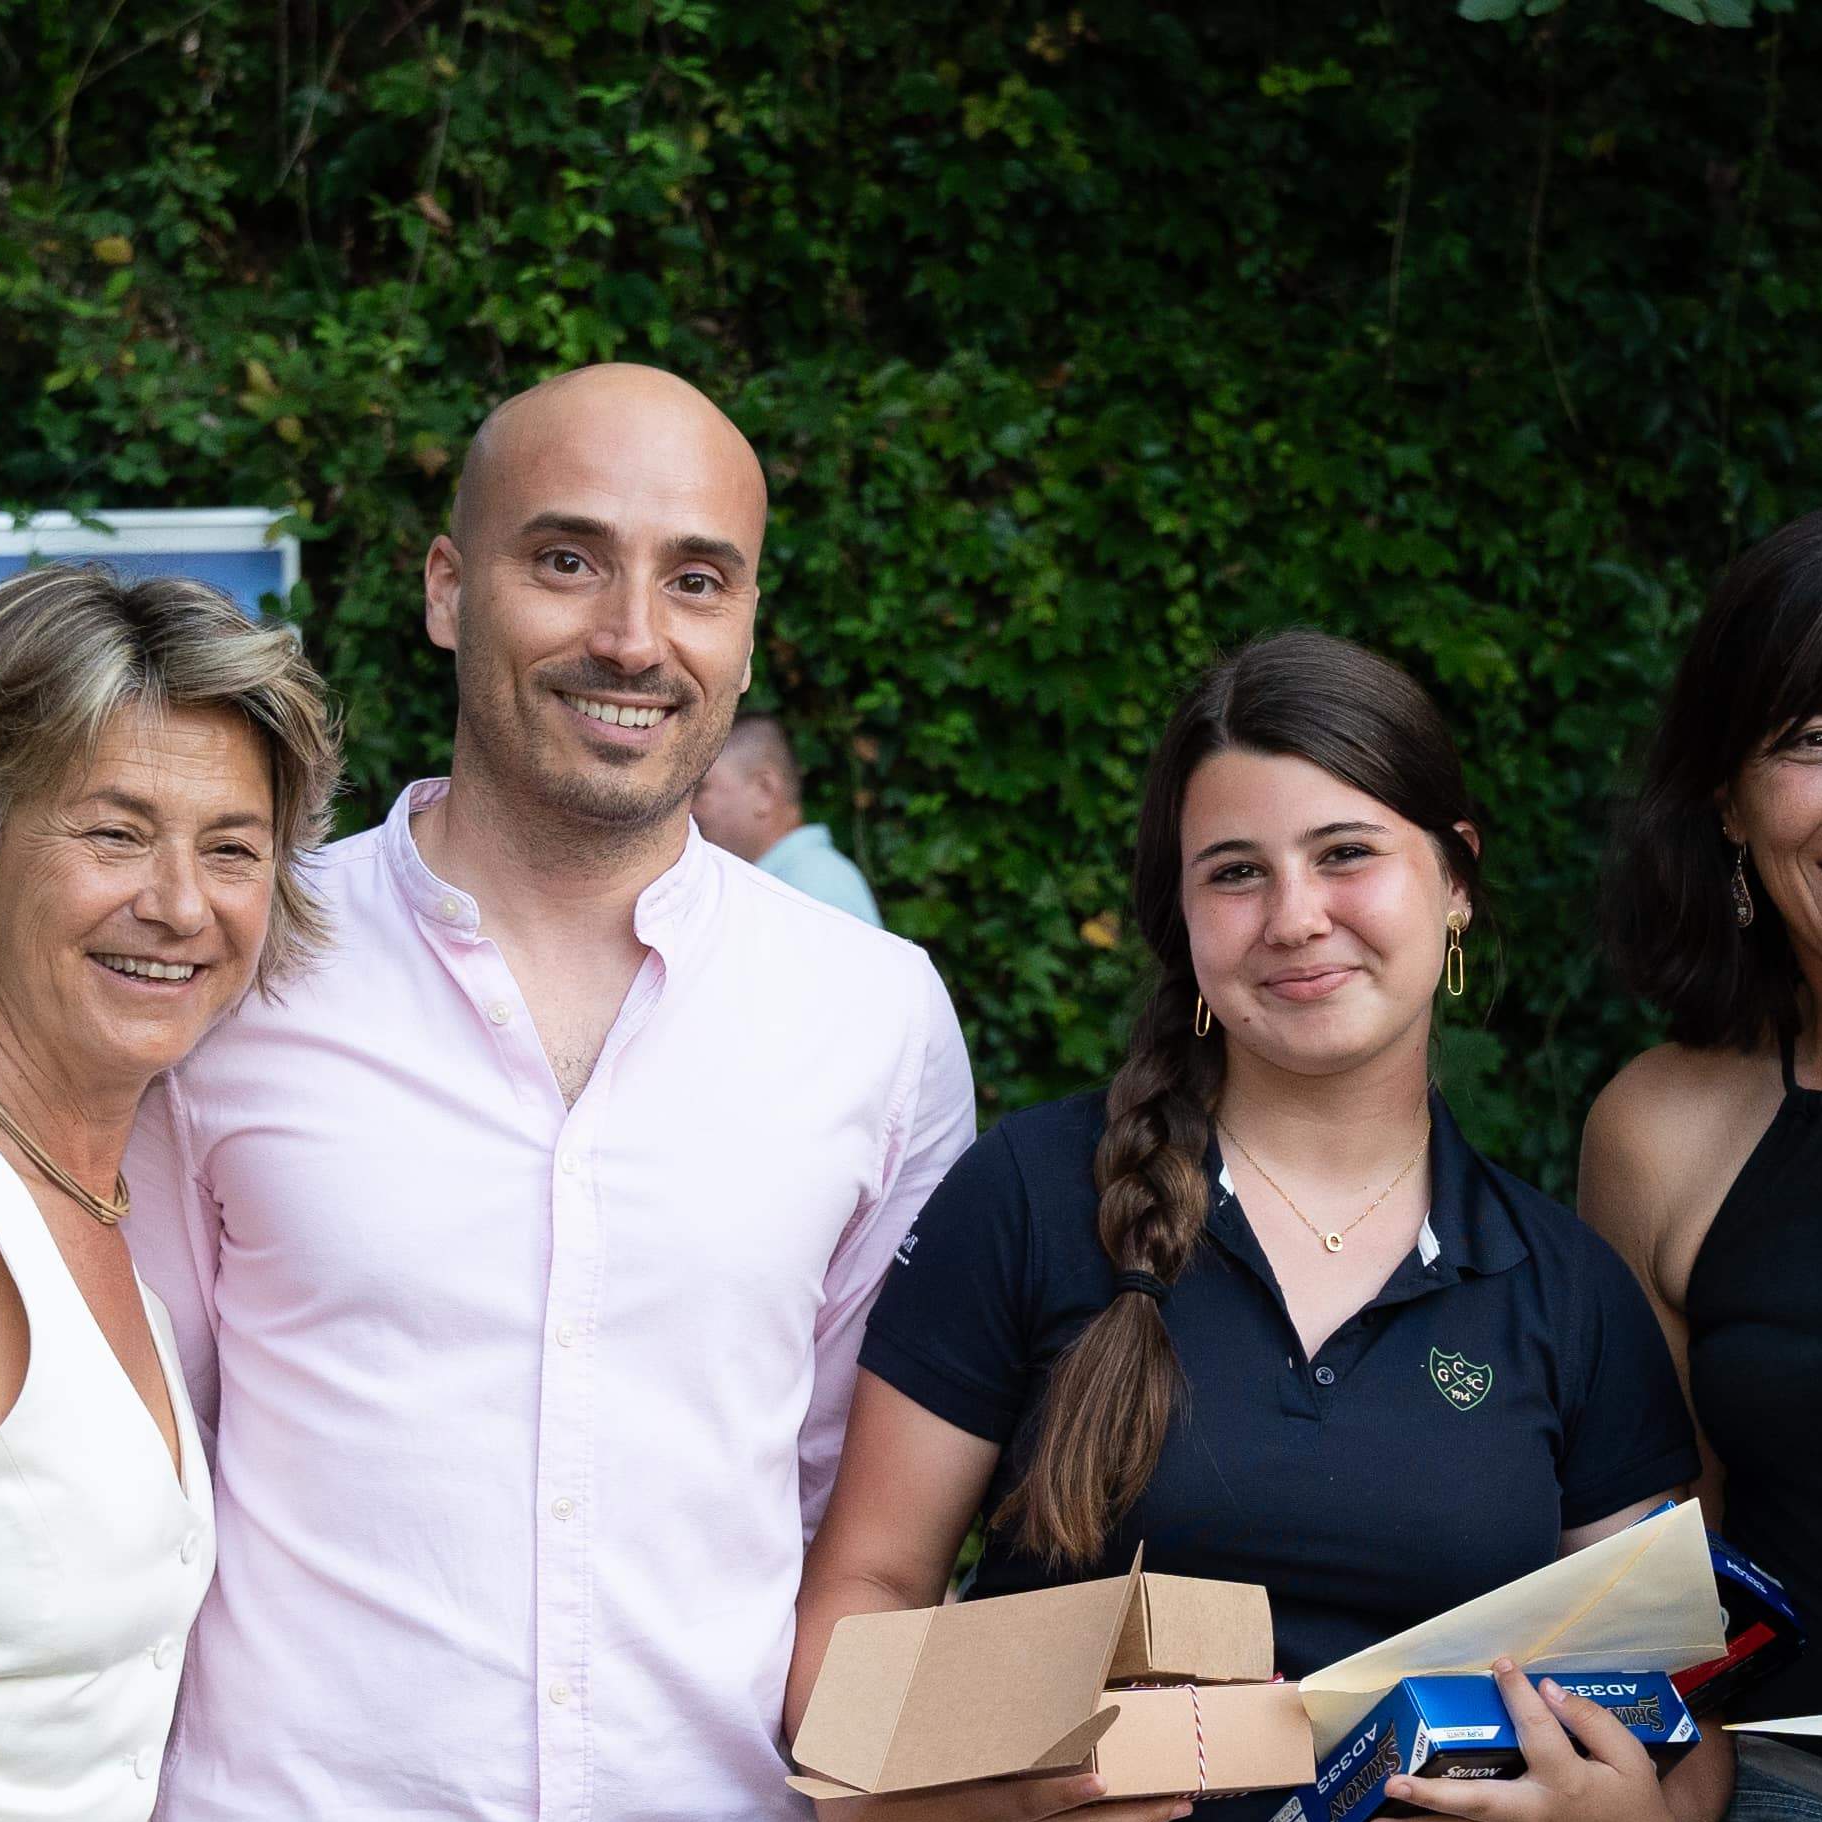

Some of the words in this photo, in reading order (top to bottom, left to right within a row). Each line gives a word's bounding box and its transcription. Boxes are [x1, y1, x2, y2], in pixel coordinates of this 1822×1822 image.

[1316, 1722, 1378, 1795] AD333
[1414, 1732, 1427, 1761] NEW
[1441, 1765, 1502, 1778] SRIXON
